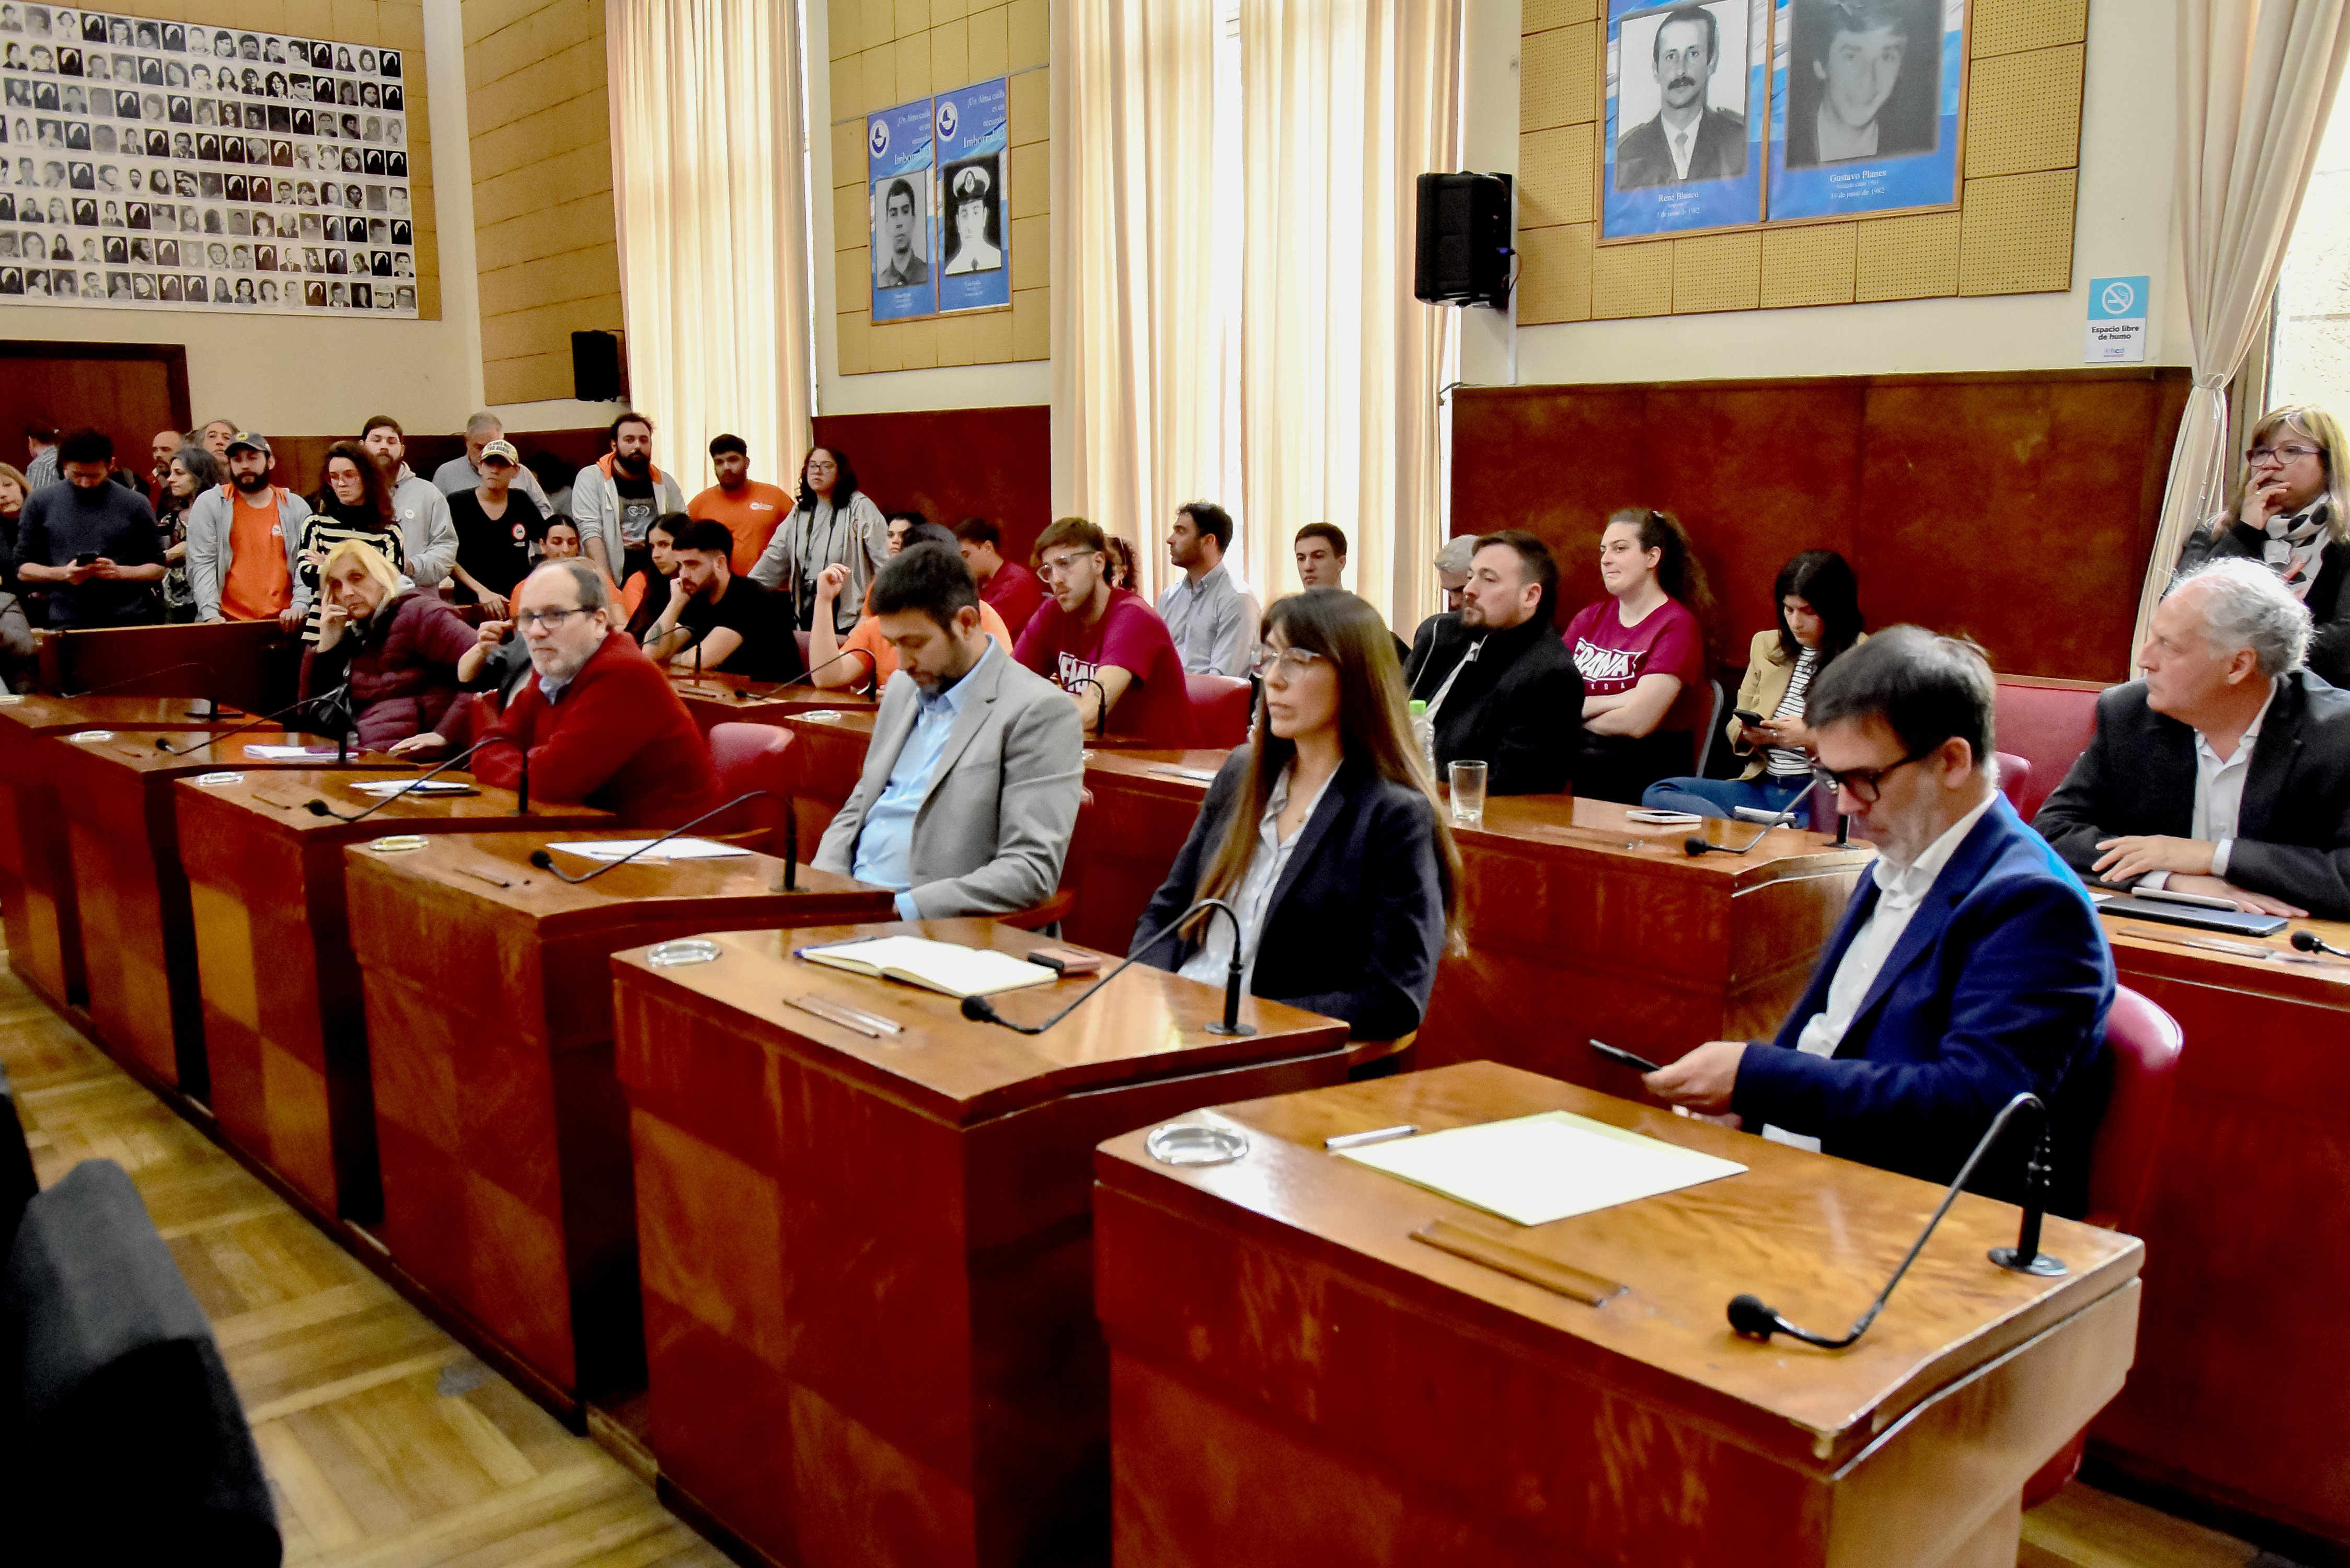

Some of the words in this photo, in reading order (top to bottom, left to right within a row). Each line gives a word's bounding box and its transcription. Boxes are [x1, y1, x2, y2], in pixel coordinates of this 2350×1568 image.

[1830, 174, 1860, 182] Gustavo
[1862, 170, 1886, 179] Planes
[1658, 193, 1675, 202] René
[2091, 326, 2120, 334] Espacio
